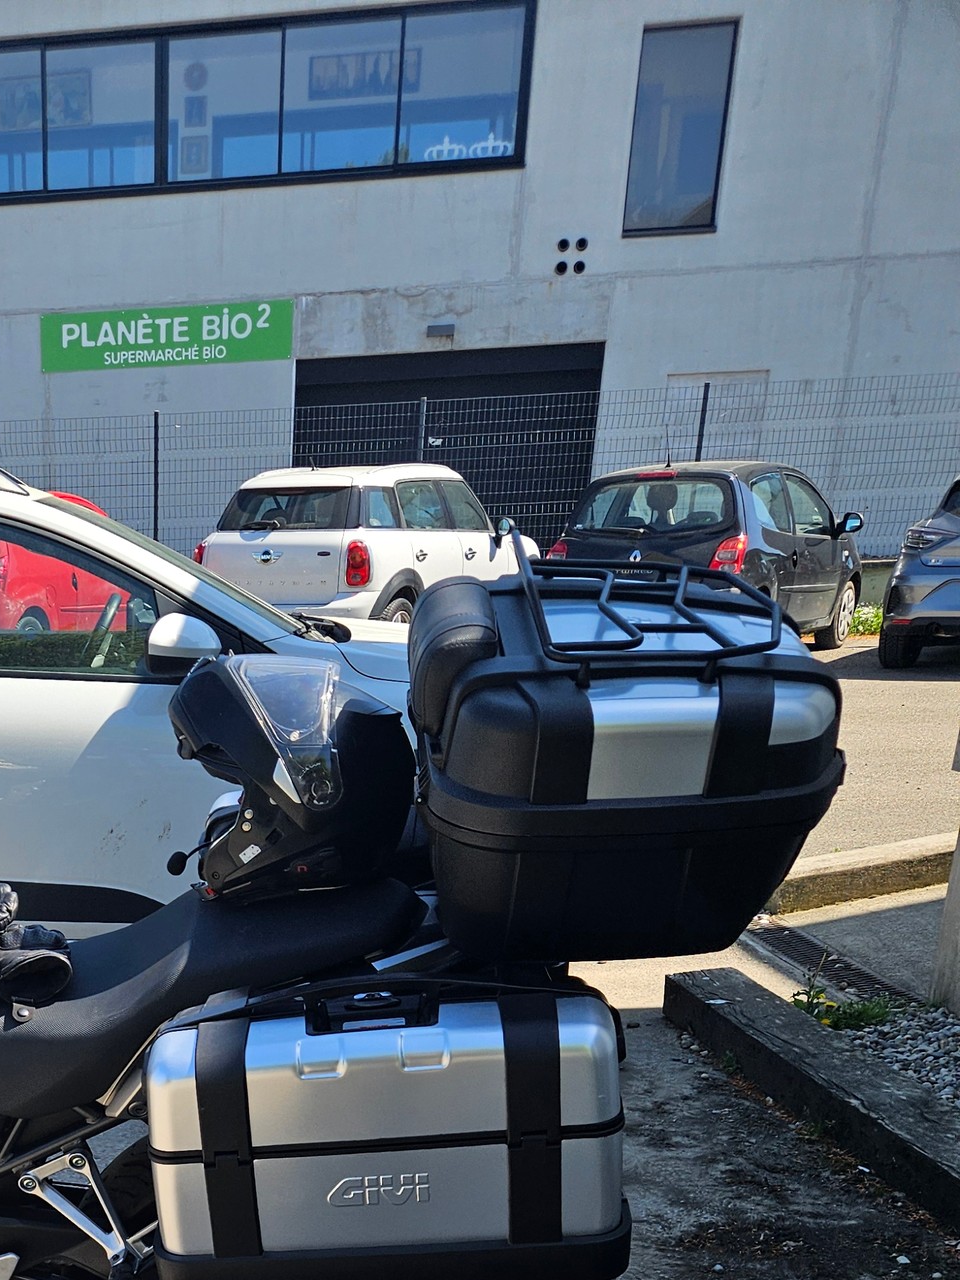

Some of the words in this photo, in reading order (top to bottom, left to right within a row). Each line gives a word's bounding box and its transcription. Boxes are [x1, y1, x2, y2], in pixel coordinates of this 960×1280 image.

[61, 313, 190, 349] PLANÈTE
[103, 344, 200, 365] SUPERMARCHÉ
[326, 1171, 431, 1208] GIVI
